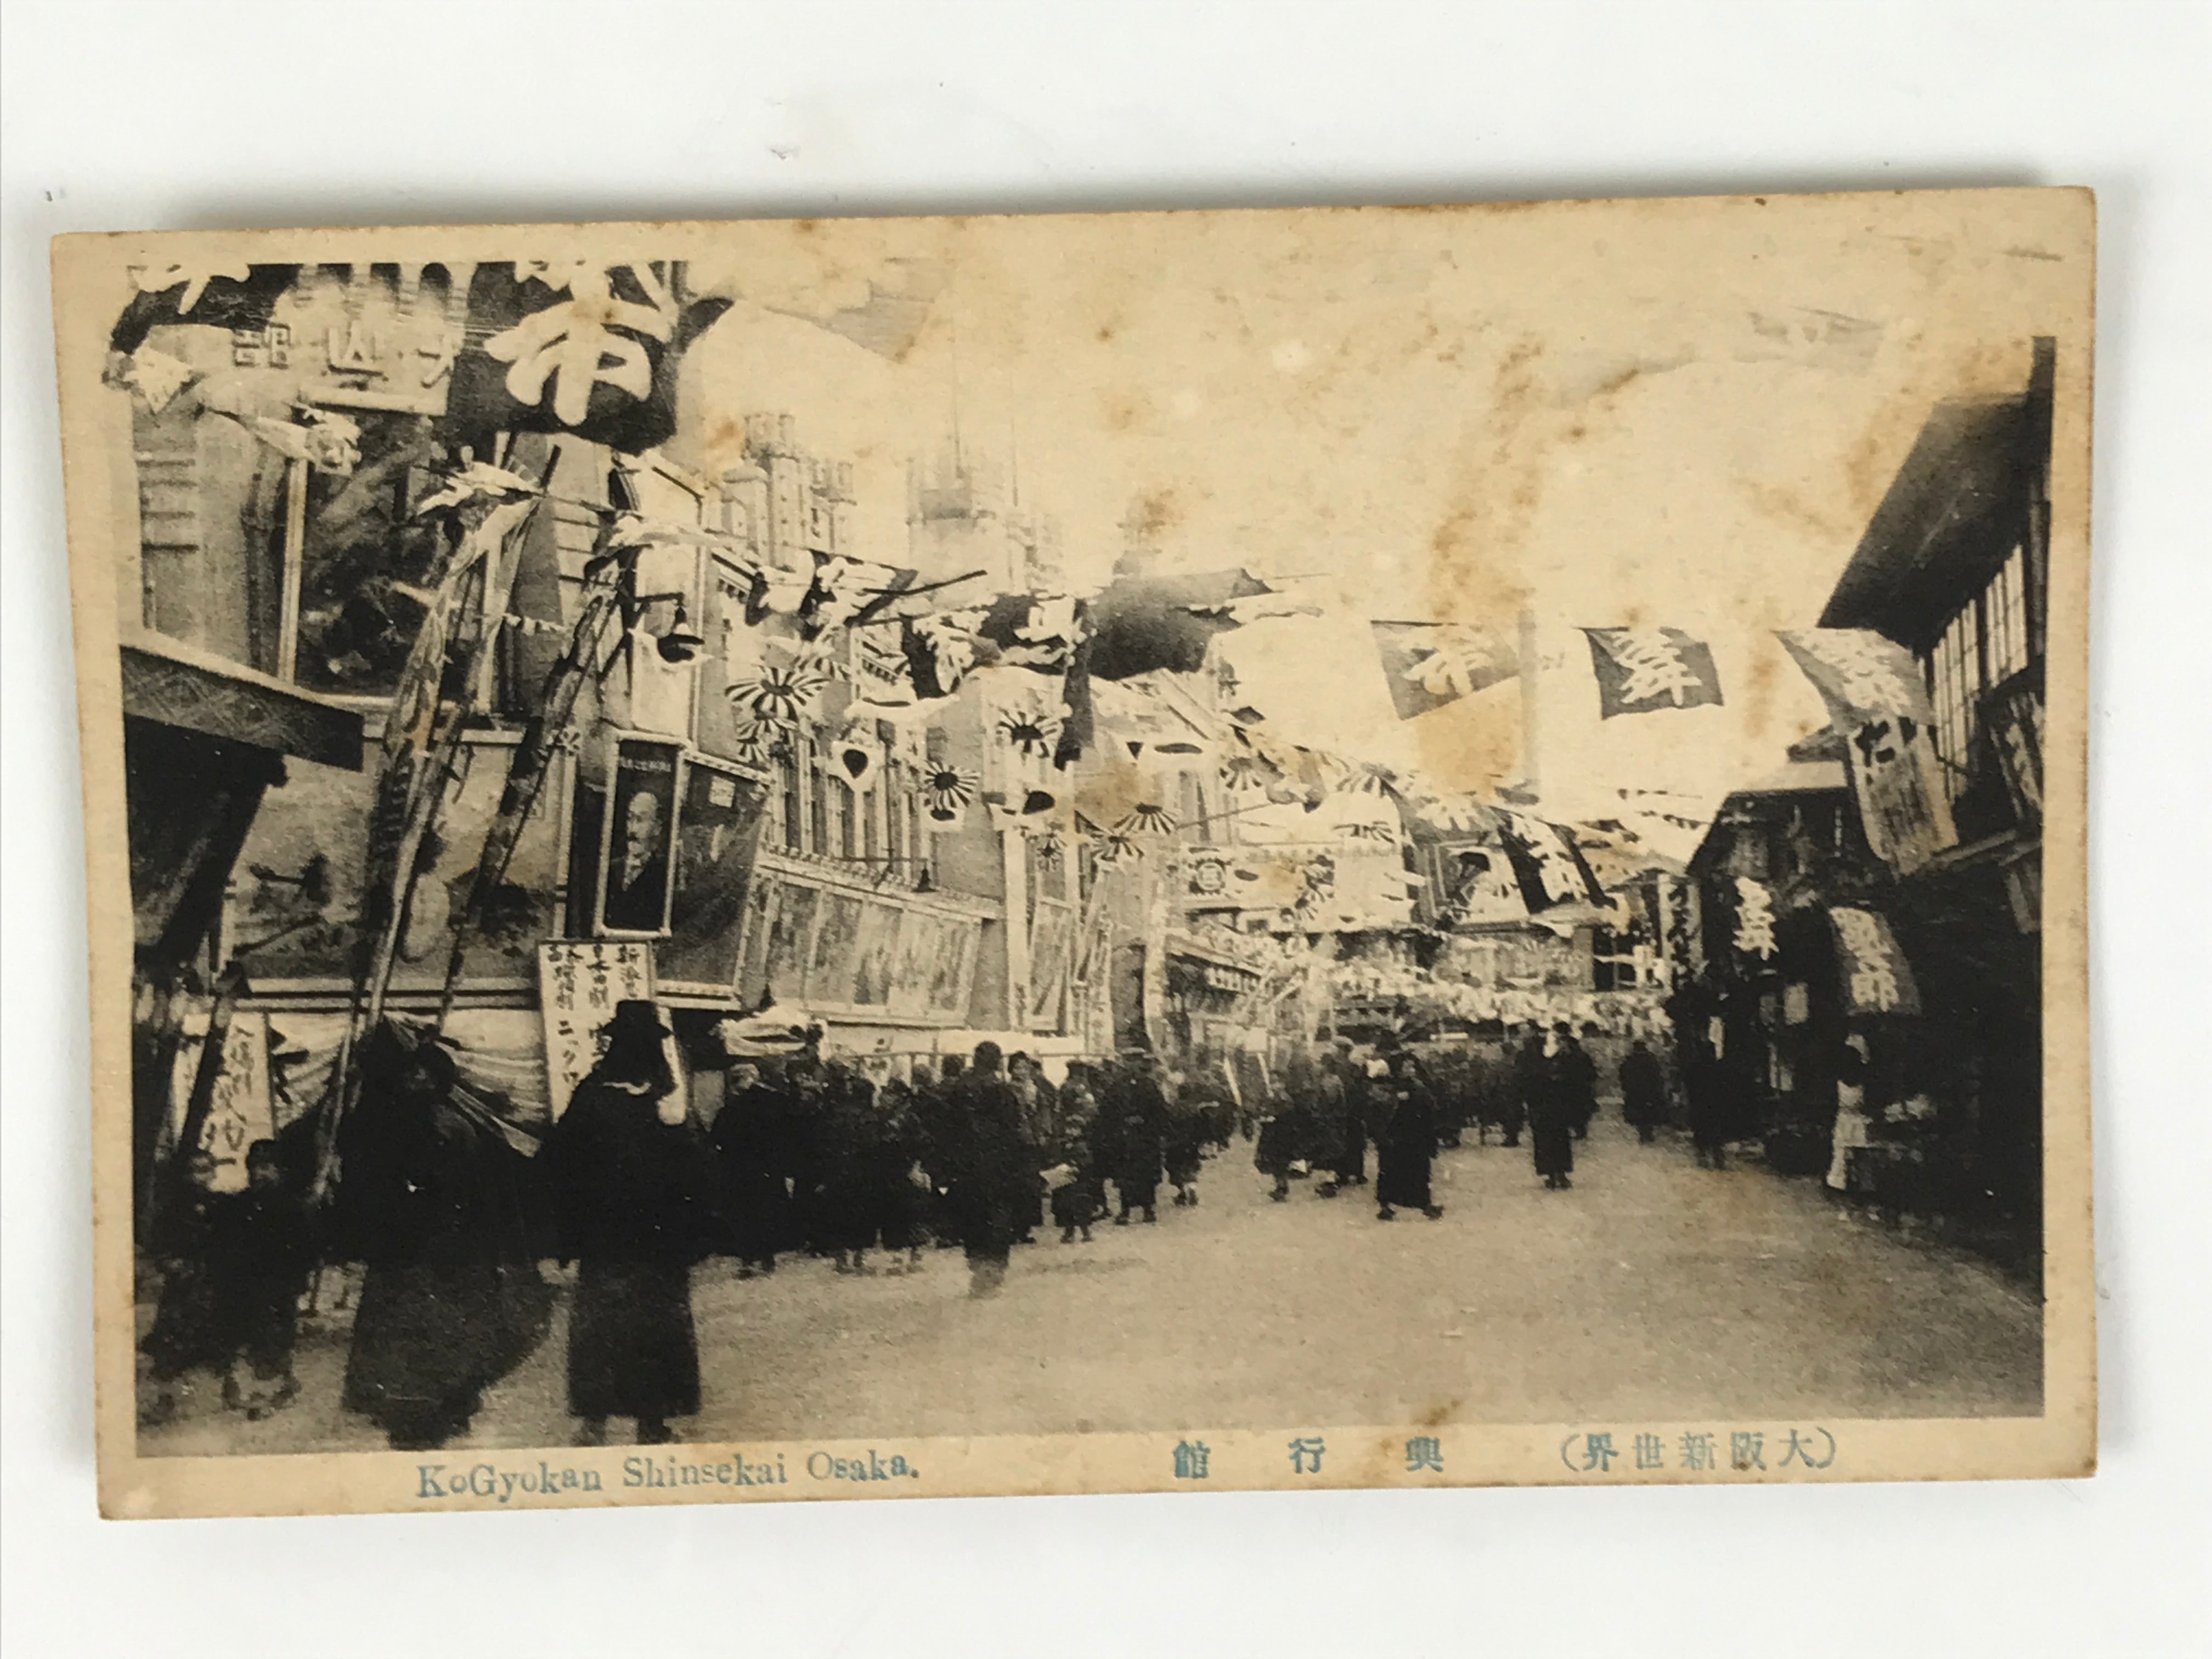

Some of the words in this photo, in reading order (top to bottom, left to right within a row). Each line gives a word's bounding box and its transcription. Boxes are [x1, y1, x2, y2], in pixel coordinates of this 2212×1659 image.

[417, 1462, 603, 1503] KoGyokan
[622, 1453, 787, 1487] Shinsekai
[808, 1449, 919, 1481] Osaka.
